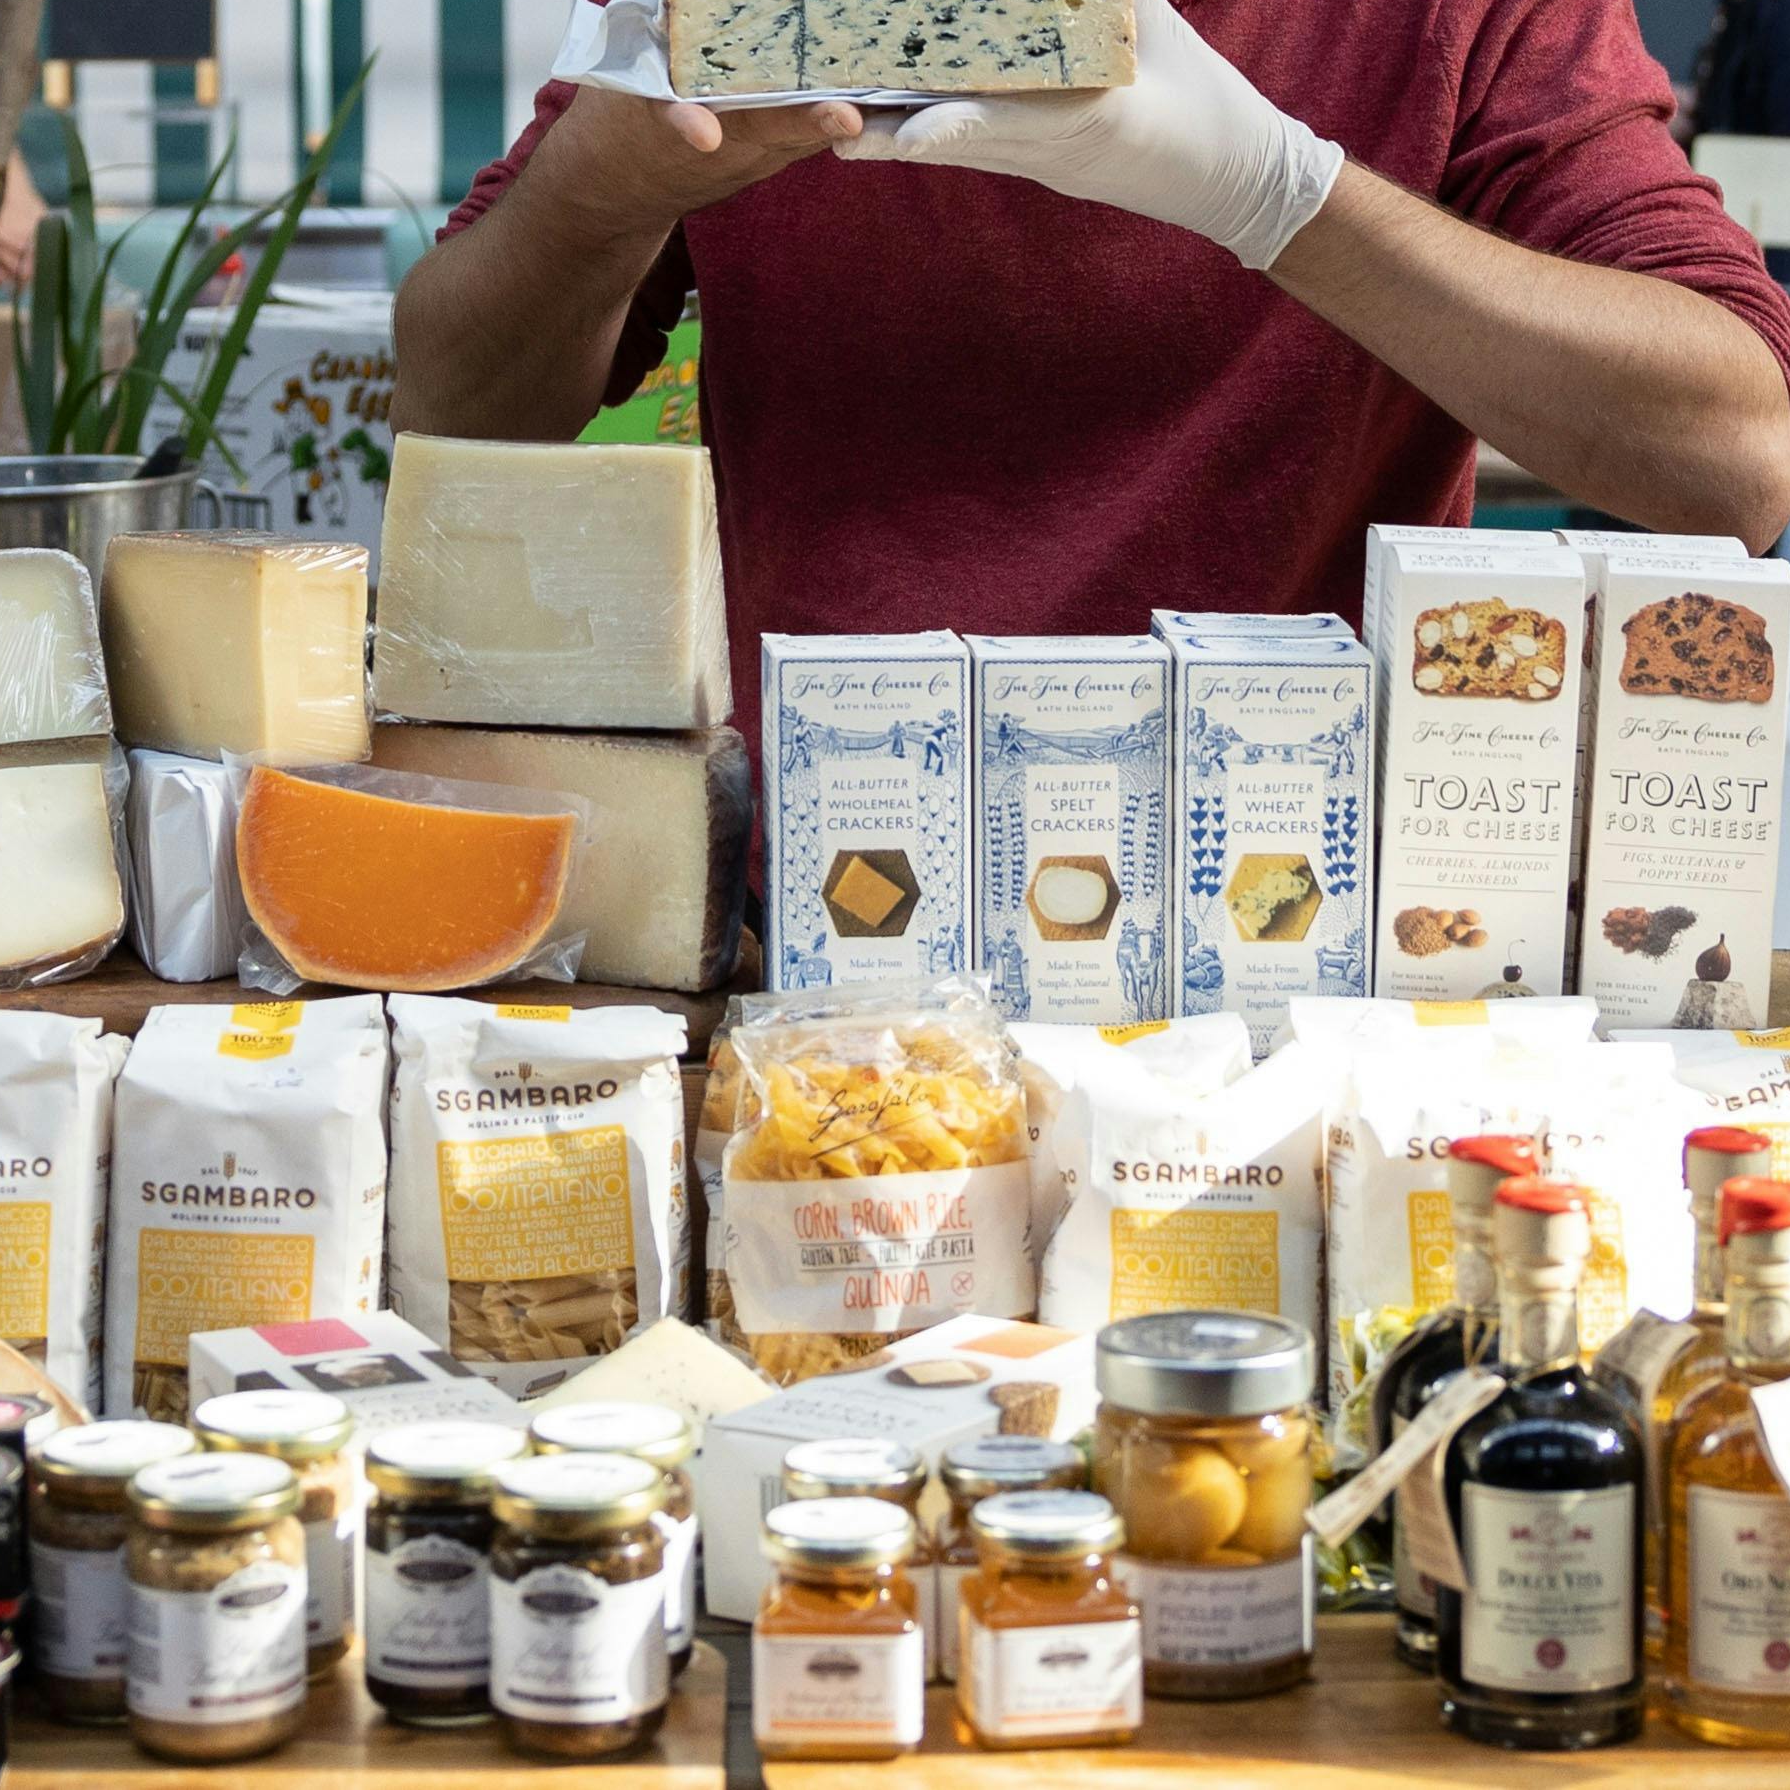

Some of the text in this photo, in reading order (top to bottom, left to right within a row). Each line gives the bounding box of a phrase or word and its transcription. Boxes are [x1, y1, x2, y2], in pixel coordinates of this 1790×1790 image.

[826, 673, 922, 698] FINE CHEESE
[1029, 674, 1125, 699] FINE CHEESE
[1231, 677, 1327, 701] FINE CHEESE
[1488, 723, 1535, 747] CHEESE
[1693, 721, 1741, 745] CHEESE
[831, 779, 909, 790] ALL-BUTTER
[1034, 781, 1111, 792] ALL-BUTTER
[1237, 783, 1313, 794] ALL-BUTTER
[1404, 773, 1561, 813] TOAST
[1610, 769, 1768, 812] TOAST
[828, 799, 912, 810] WHOLEMEAL
[1051, 799, 1096, 811] SPELT
[1245, 801, 1305, 813] WHEAT
[827, 817, 914, 830] CRACKERS
[1031, 819, 1115, 832] CRACKERS
[1232, 821, 1318, 833] CRACKERS
[1399, 816, 1560, 842] FOR CHEESE
[1605, 812, 1769, 841] FOR CHEESE
[1484, 858, 1551, 872] ALMONDS
[1622, 851, 1731, 869] FIGS, SULTANAS
[1451, 874, 1519, 886] LINSEEDS
[1638, 868, 1728, 884] POPPY SEEDS
[849, 958, 902, 970] Made From
[1046, 960, 1100, 972] Made From
[1246, 963, 1299, 975] Made From
[1037, 976, 1110, 990] Simple, Natural
[1236, 980, 1308, 995] Simple, Natural
[1047, 995, 1099, 1008] Ingredients
[436, 1079, 618, 1111] SGAMBARO
[468, 1118, 509, 1128] MOLINO
[474, 1131, 620, 1159] DORATO CHICCO
[1113, 1161, 1284, 1186] SGAMBARO
[141, 1181, 316, 1209] SGAMBARO
[513, 1173, 624, 1208] ITALIANO
[852, 1197, 919, 1235] BROWN
[175, 1234, 310, 1253] DORATO CHICCO
[466, 1232, 520, 1248] NOSTRE
[941, 1238, 974, 1258] PASTA
[482, 1249, 628, 1276] CAMPI CUORE
[204, 1278, 307, 1302] ITALIANO
[842, 1269, 931, 1309] QUINOA
